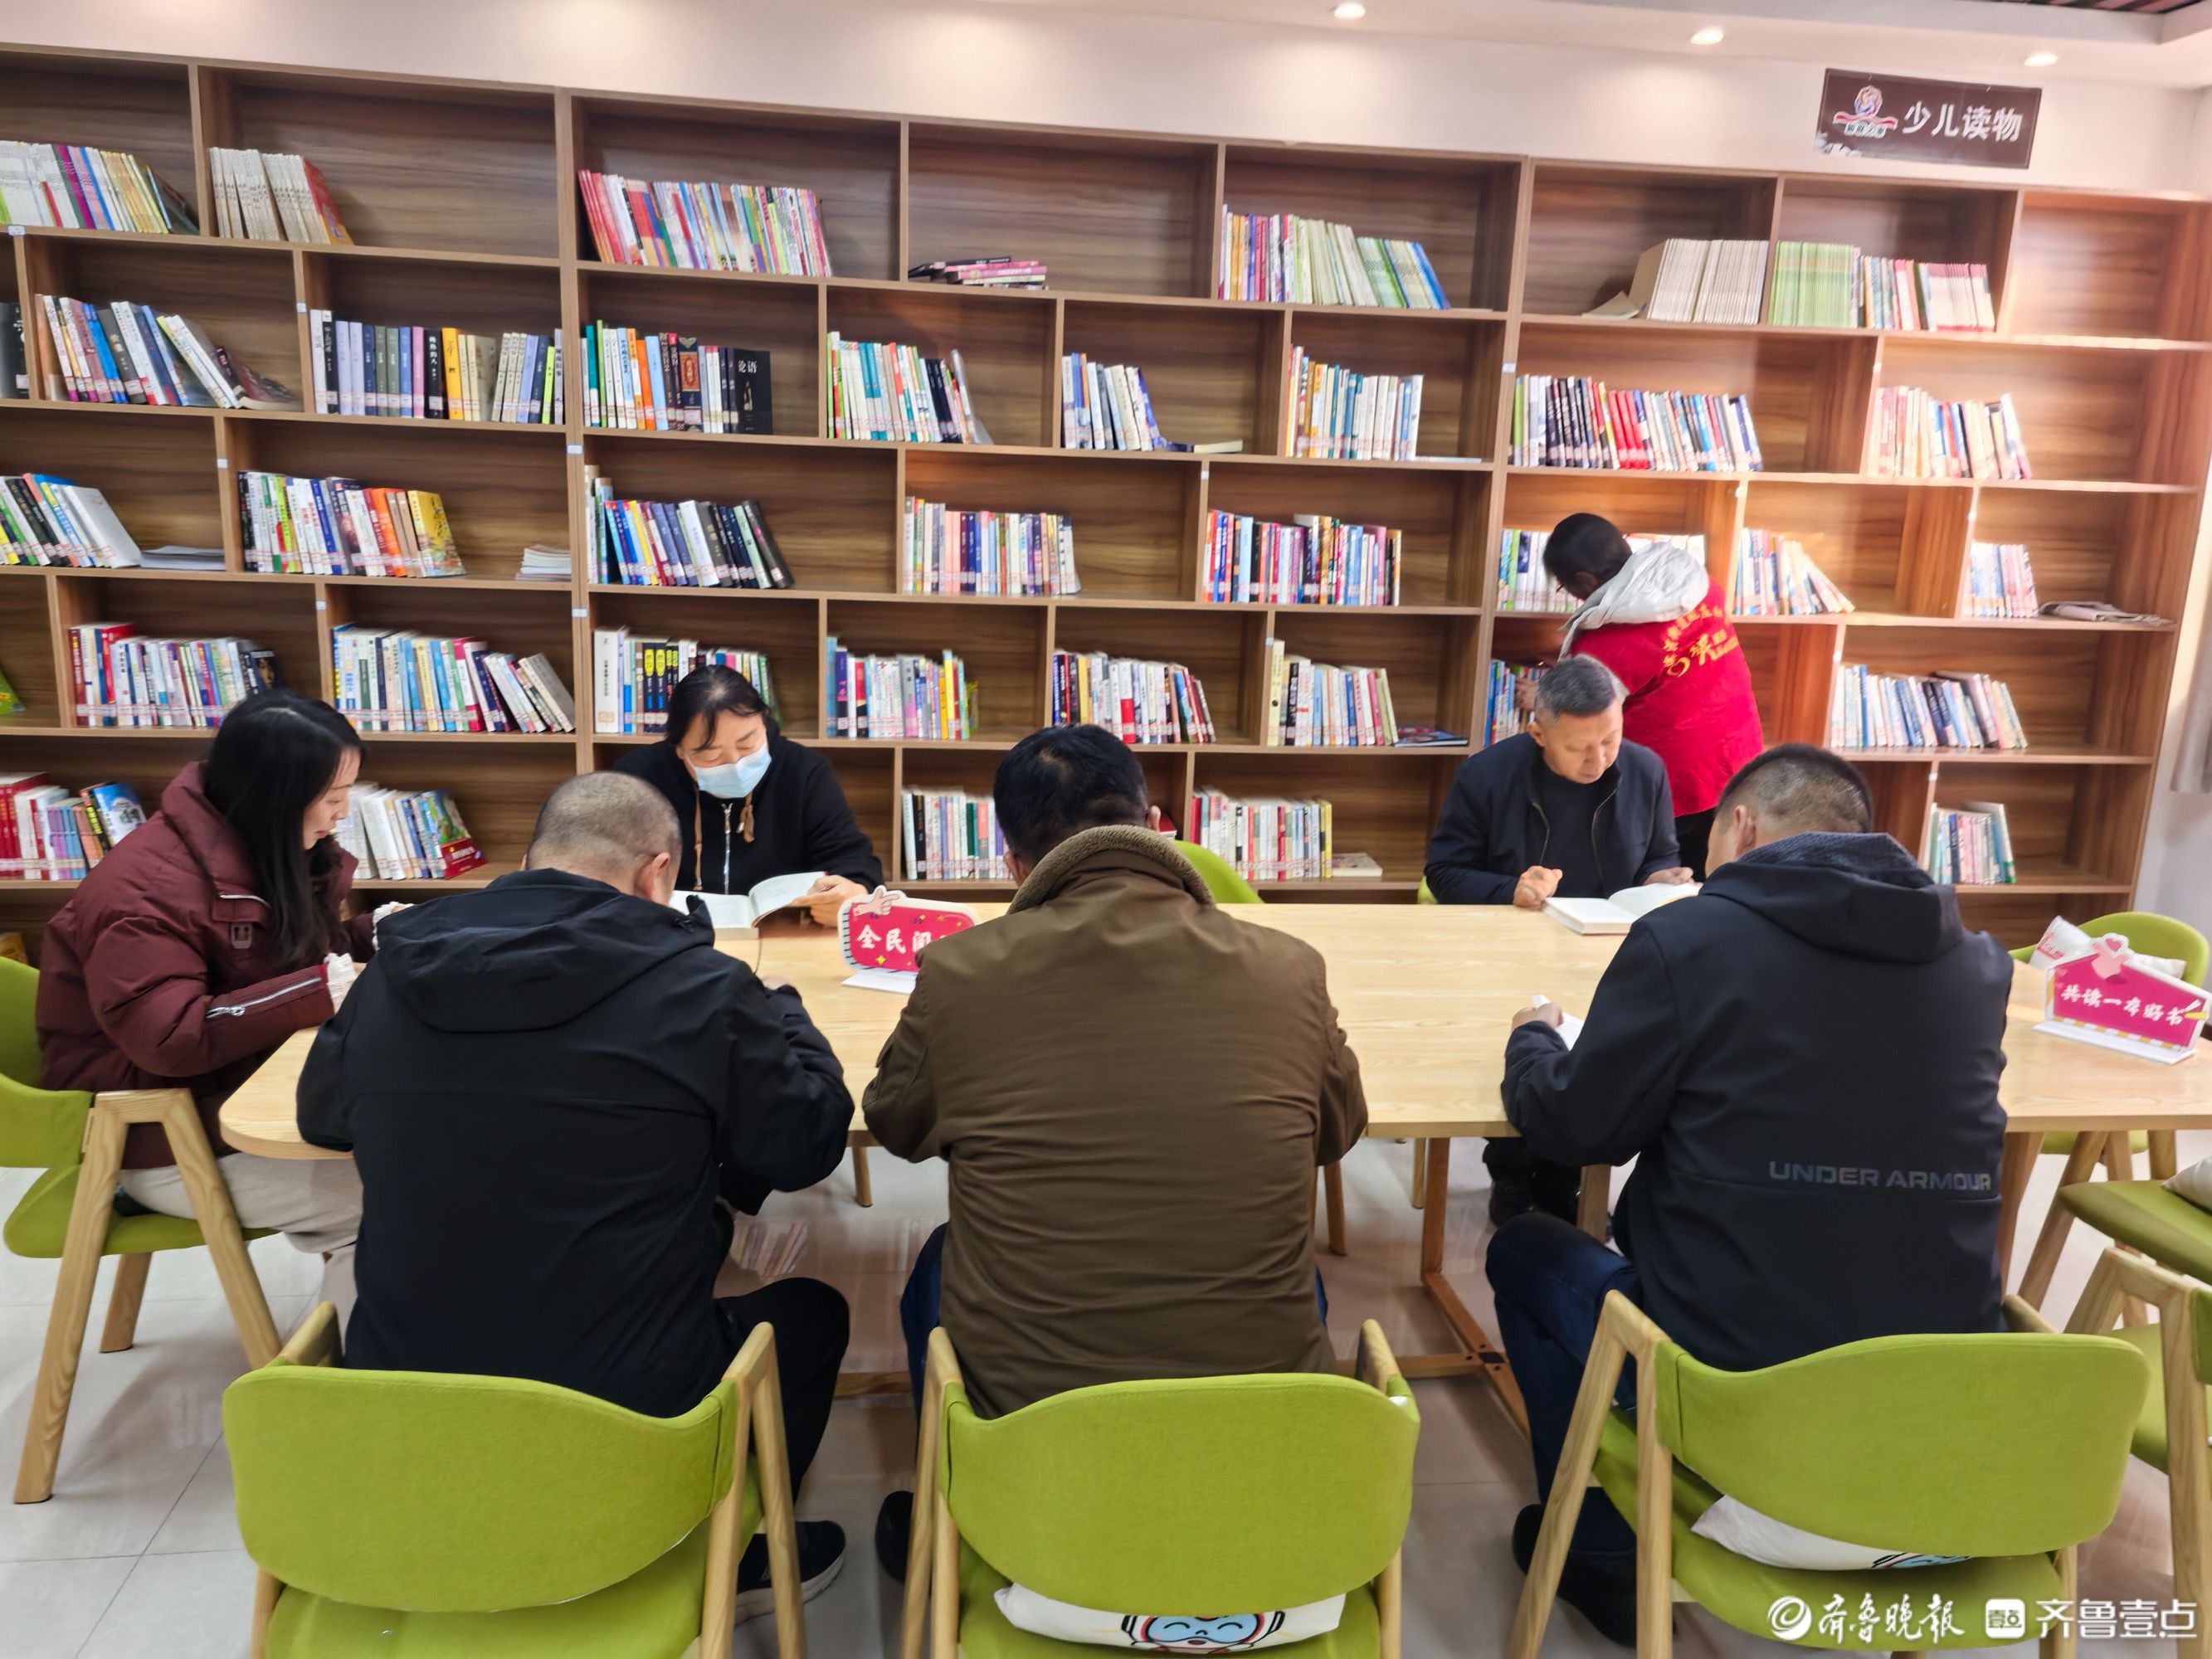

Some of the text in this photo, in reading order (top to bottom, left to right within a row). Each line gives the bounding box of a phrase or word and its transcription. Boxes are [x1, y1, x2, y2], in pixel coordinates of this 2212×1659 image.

[1903, 100, 2023, 142] 少儿读物
[738, 359, 758, 374] 论语
[856, 924, 948, 954] 全民阅
[1769, 1160, 1991, 1191] UNDER ARMOUR
